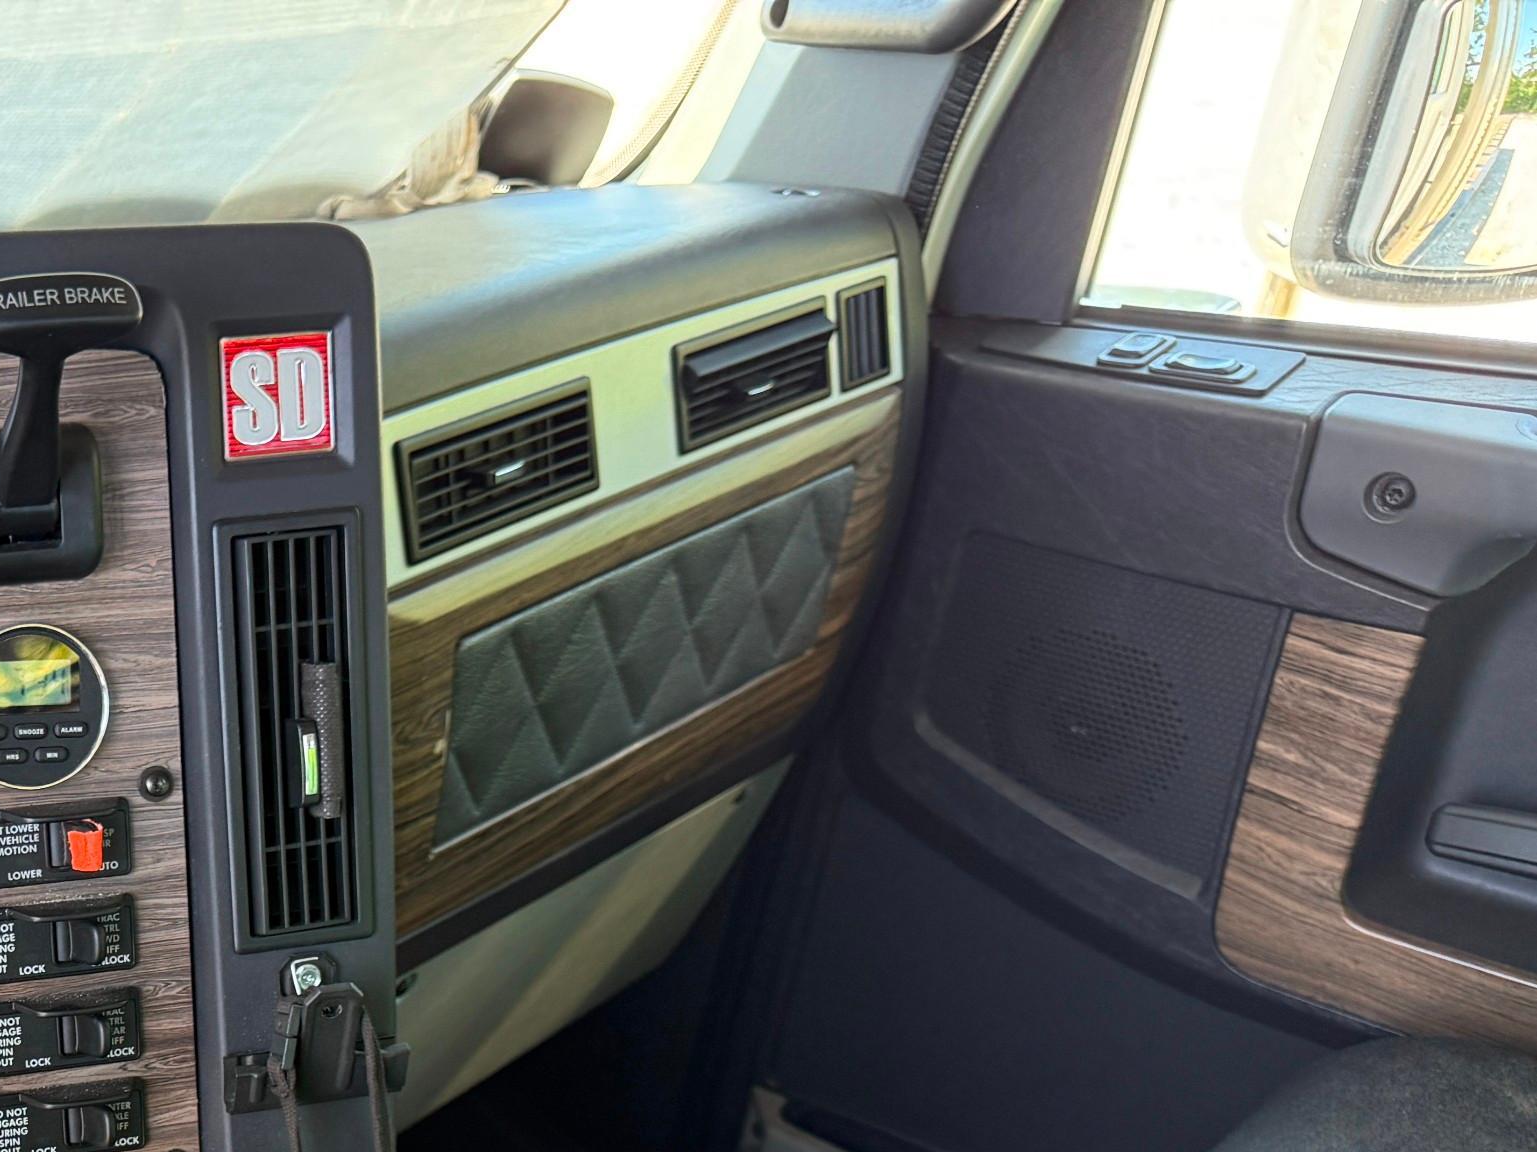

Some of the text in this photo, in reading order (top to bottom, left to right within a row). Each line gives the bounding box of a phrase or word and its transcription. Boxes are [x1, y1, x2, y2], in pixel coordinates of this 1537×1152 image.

[64, 287, 127, 305] BRAKE
[229, 346, 327, 447] SD
[18, 728, 45, 736] SNOOZE
[61, 726, 83, 734] ALARM
[5, 823, 40, 835] LOWER
[0, 834, 40, 846] VEHICLE
[7, 869, 43, 881] LOWER
[19, 965, 46, 976] LOCK
[0, 1016, 21, 1027] NOT
[25, 1057, 51, 1068] LOCK
[6, 1107, 28, 1117] NOT
[0, 1138, 21, 1148] SPIN
